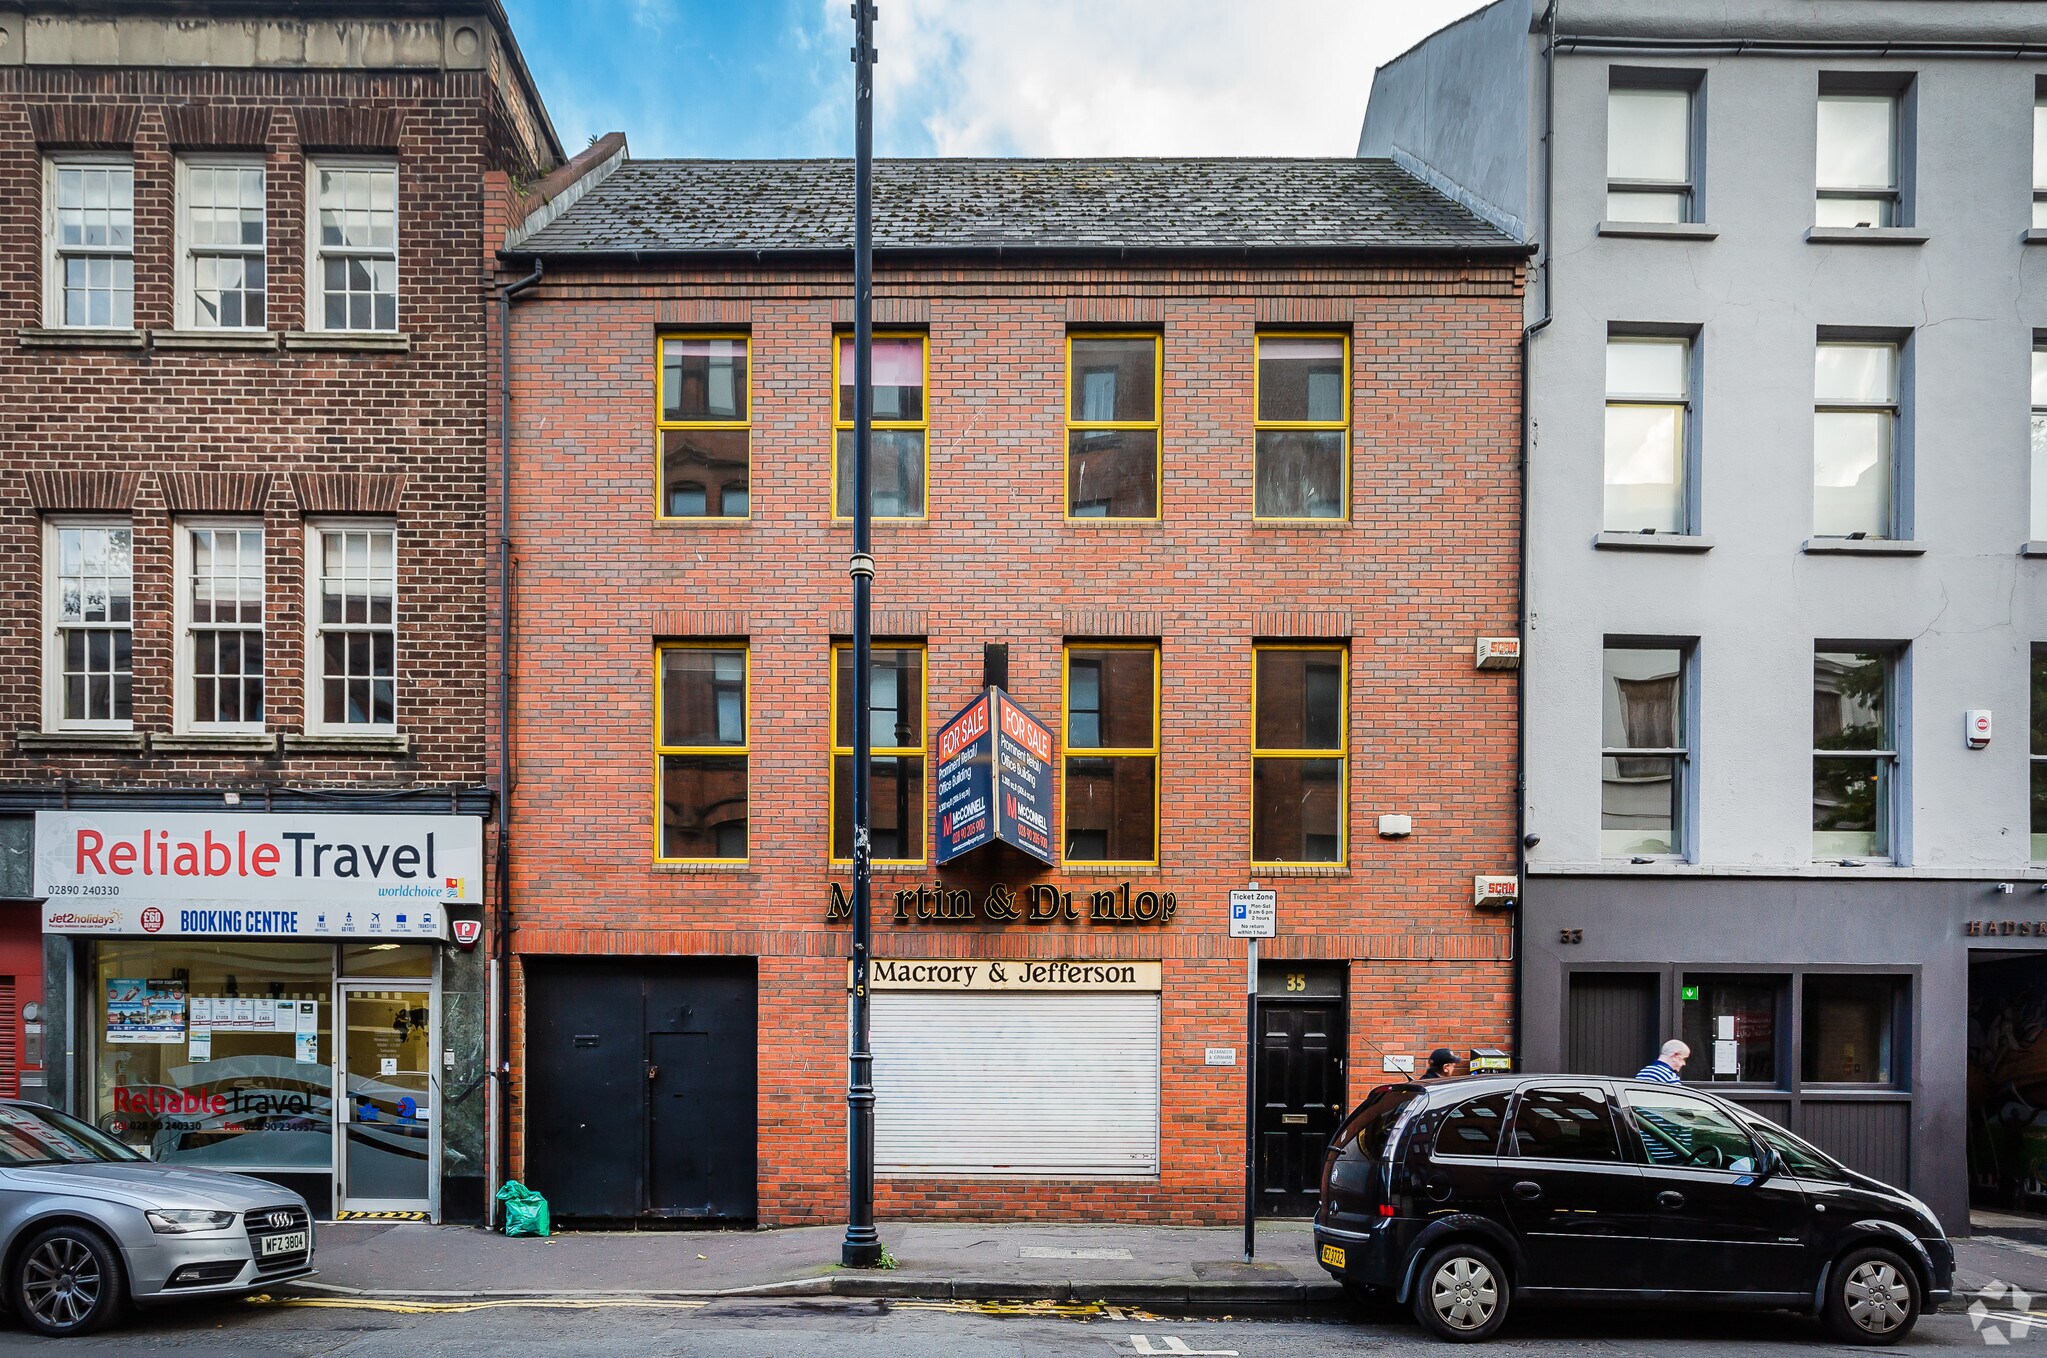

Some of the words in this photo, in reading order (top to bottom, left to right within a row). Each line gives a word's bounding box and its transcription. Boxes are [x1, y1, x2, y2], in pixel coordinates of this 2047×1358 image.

[1491, 641, 1518, 653] SCAN
[943, 726, 960, 758] FOR
[961, 705, 984, 743] SALE
[1005, 706, 1025, 741] FOR
[1027, 723, 1048, 758] SALE
[1000, 734, 1026, 763] Prominent
[939, 755, 960, 781] Prominent
[1000, 752, 1016, 773] Office
[1016, 761, 1036, 789] Building
[939, 780, 952, 796] Office
[952, 766, 972, 788] Building
[976, 817, 986, 832] 900
[48, 885, 79, 895] 02890
[82, 885, 120, 896] 240330
[378, 884, 442, 897] worldchoice
[1488, 882, 1515, 893] SCAN
[984, 882, 1021, 919] &
[143, 911, 161, 923] £60
[1236, 906, 1244, 917] P
[180, 909, 242, 932] BOOKING
[245, 910, 298, 933] CENTRE
[1560, 927, 1583, 944] 33
[873, 961, 977, 987] Macrory
[988, 962, 1009, 984] &
[1018, 962, 1136, 984] Jefferson
[1286, 973, 1306, 992] 35
[856, 985, 864, 997] 5
[130, 1121, 147, 1130] 028
[150, 1122, 163, 1130] 90
[165, 1121, 202, 1131] 240330
[264, 1122, 277, 1131] 90
[265, 1237, 283, 1252] WFZ
[284, 1234, 303, 1250] 3804
